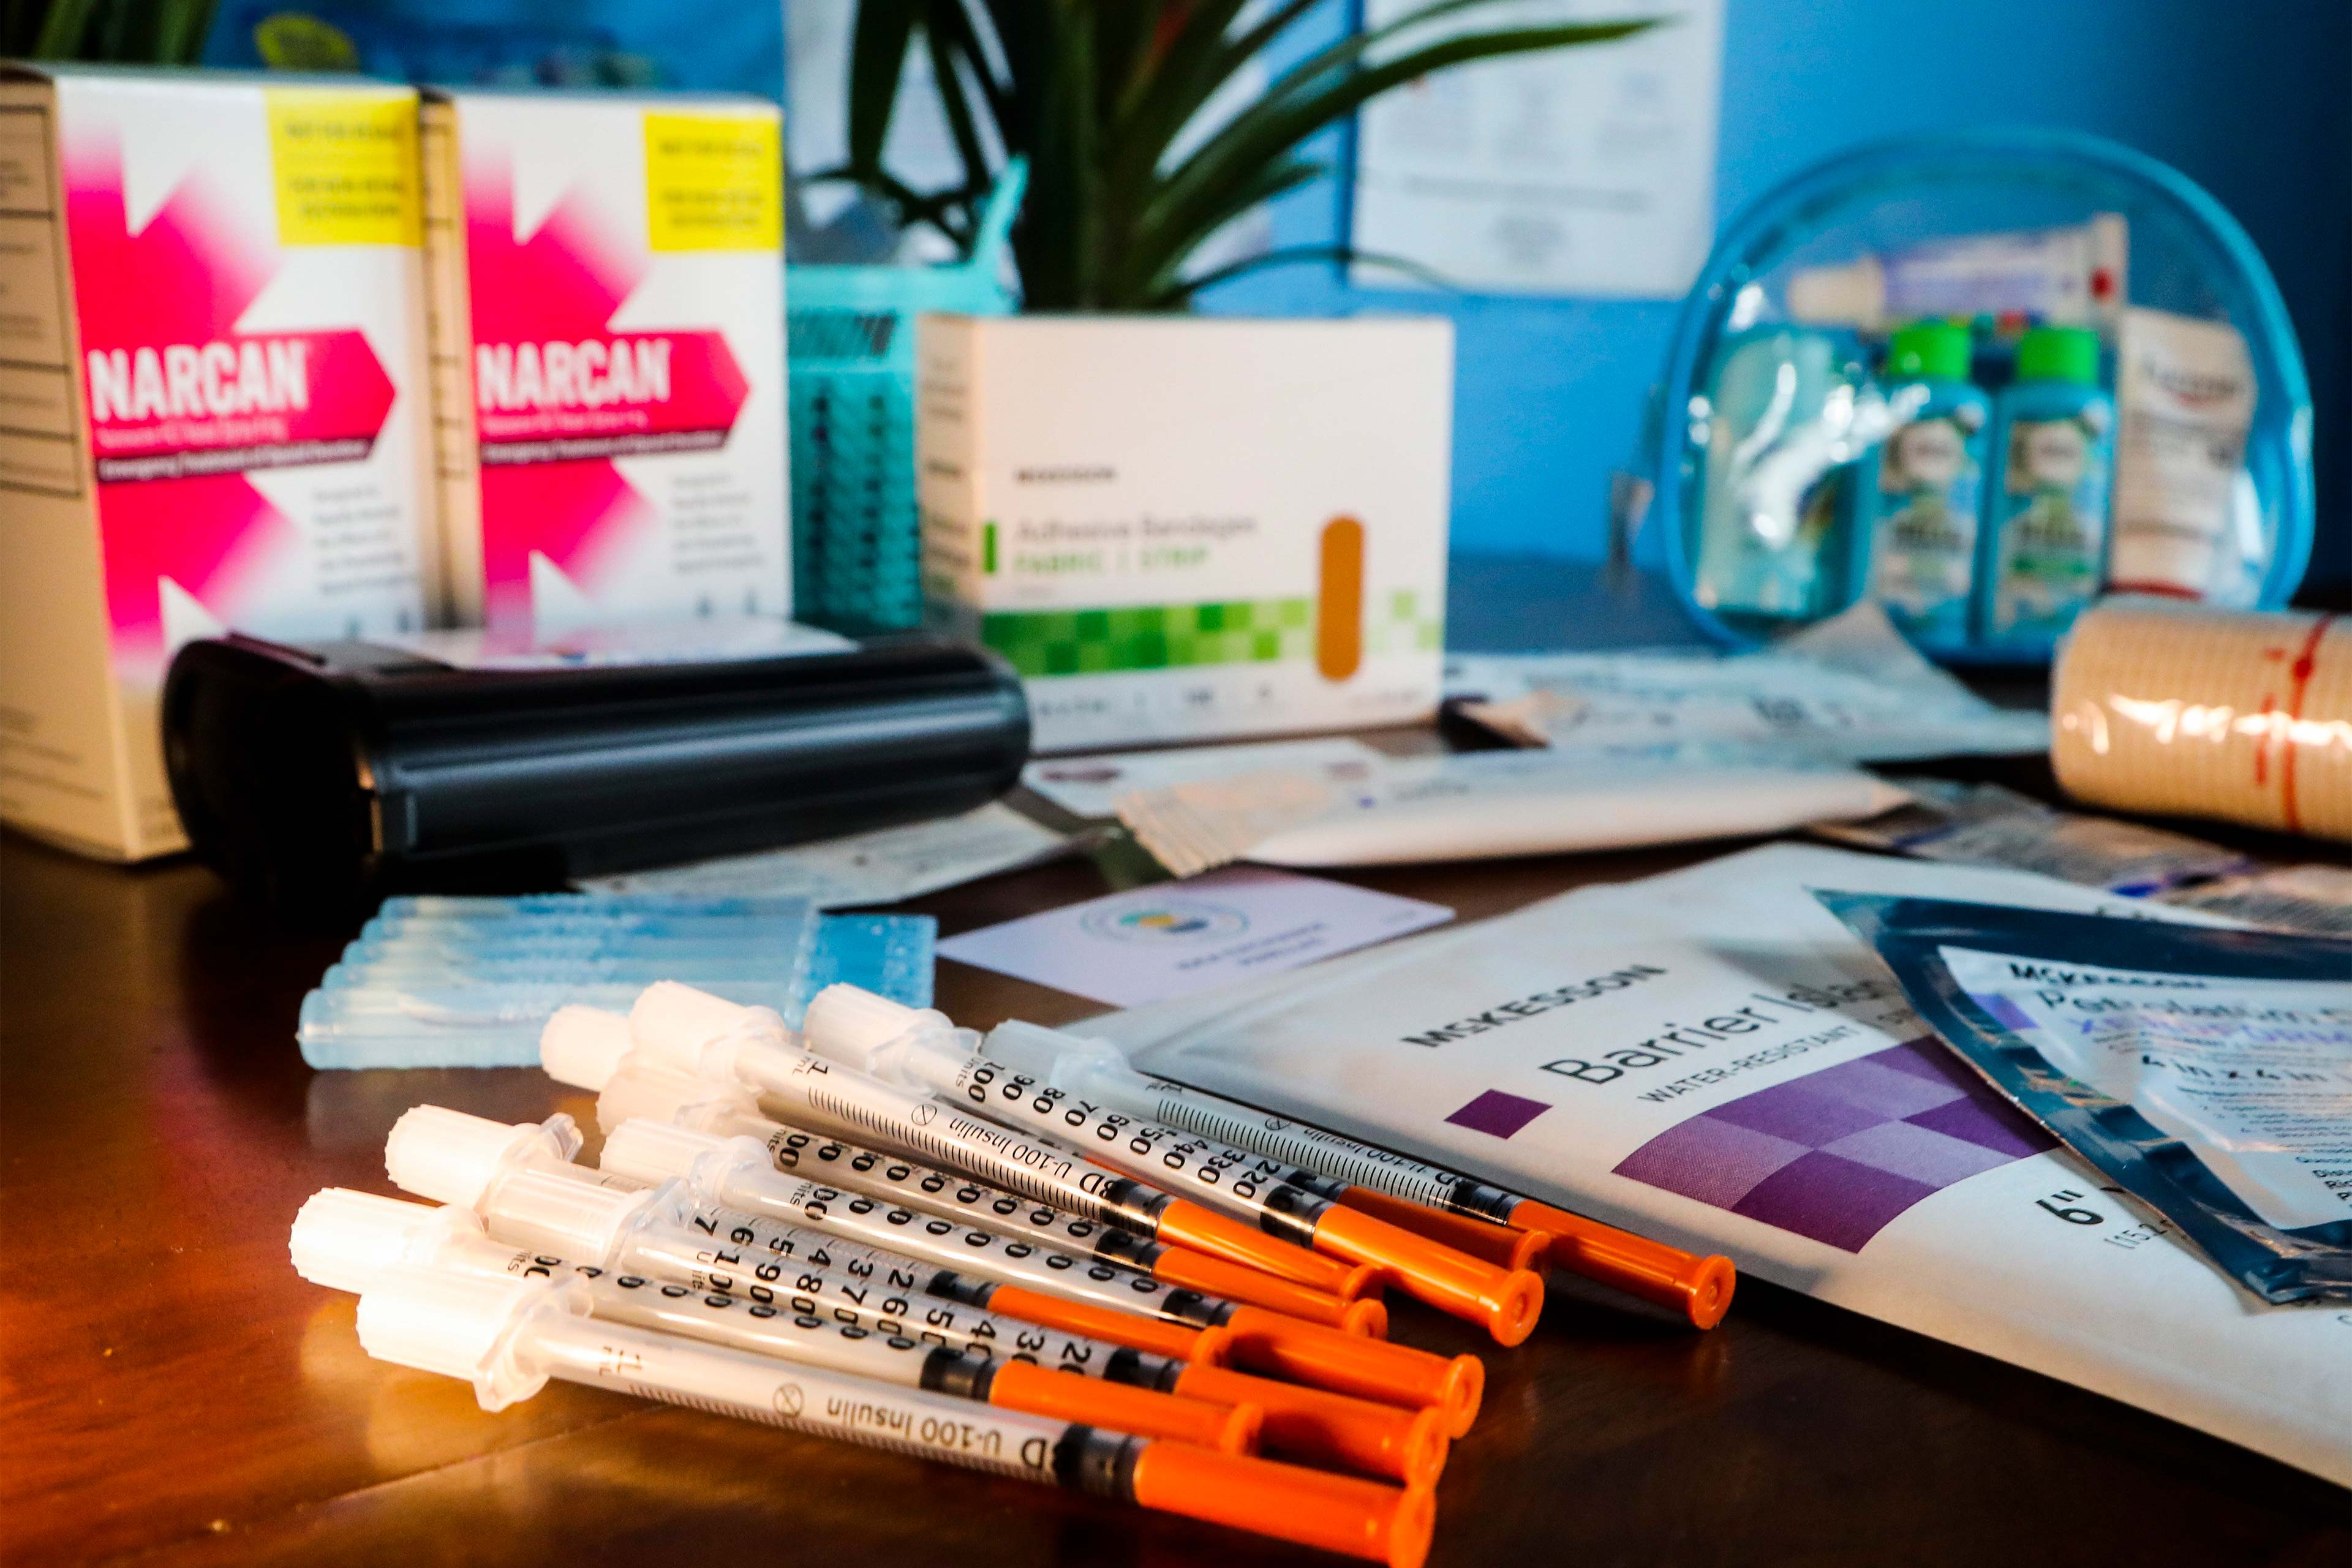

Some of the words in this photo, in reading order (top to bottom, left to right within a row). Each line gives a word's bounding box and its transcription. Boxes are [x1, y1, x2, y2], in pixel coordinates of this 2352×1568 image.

[87, 339, 307, 421] NARCAN
[476, 337, 671, 411] NARCAN
[1539, 1006, 1779, 1086] Barrier
[1636, 1025, 1861, 1103] WATER-RESISTANT
[968, 1061, 1005, 1102] 100
[1003, 1074, 1036, 1100] 90
[1033, 1087, 1066, 1114] 80
[1065, 1100, 1099, 1126] 70
[1096, 1114, 1130, 1141] 60
[949, 1117, 1012, 1154] Insulin
[1129, 1128, 1166, 1155] 50
[1012, 1144, 1072, 1178] U-100
[1163, 1142, 1195, 1170] 40
[1197, 1155, 1234, 1184] 30
[1233, 1170, 1269, 1199] 20
[750, 1262, 782, 1304] 90
[791, 1274, 822, 1314] 80
[834, 1286, 868, 1324] 70
[877, 1297, 908, 1335] 60
[826, 1396, 913, 1437] Insulin
[921, 1417, 1003, 1457] U-100
